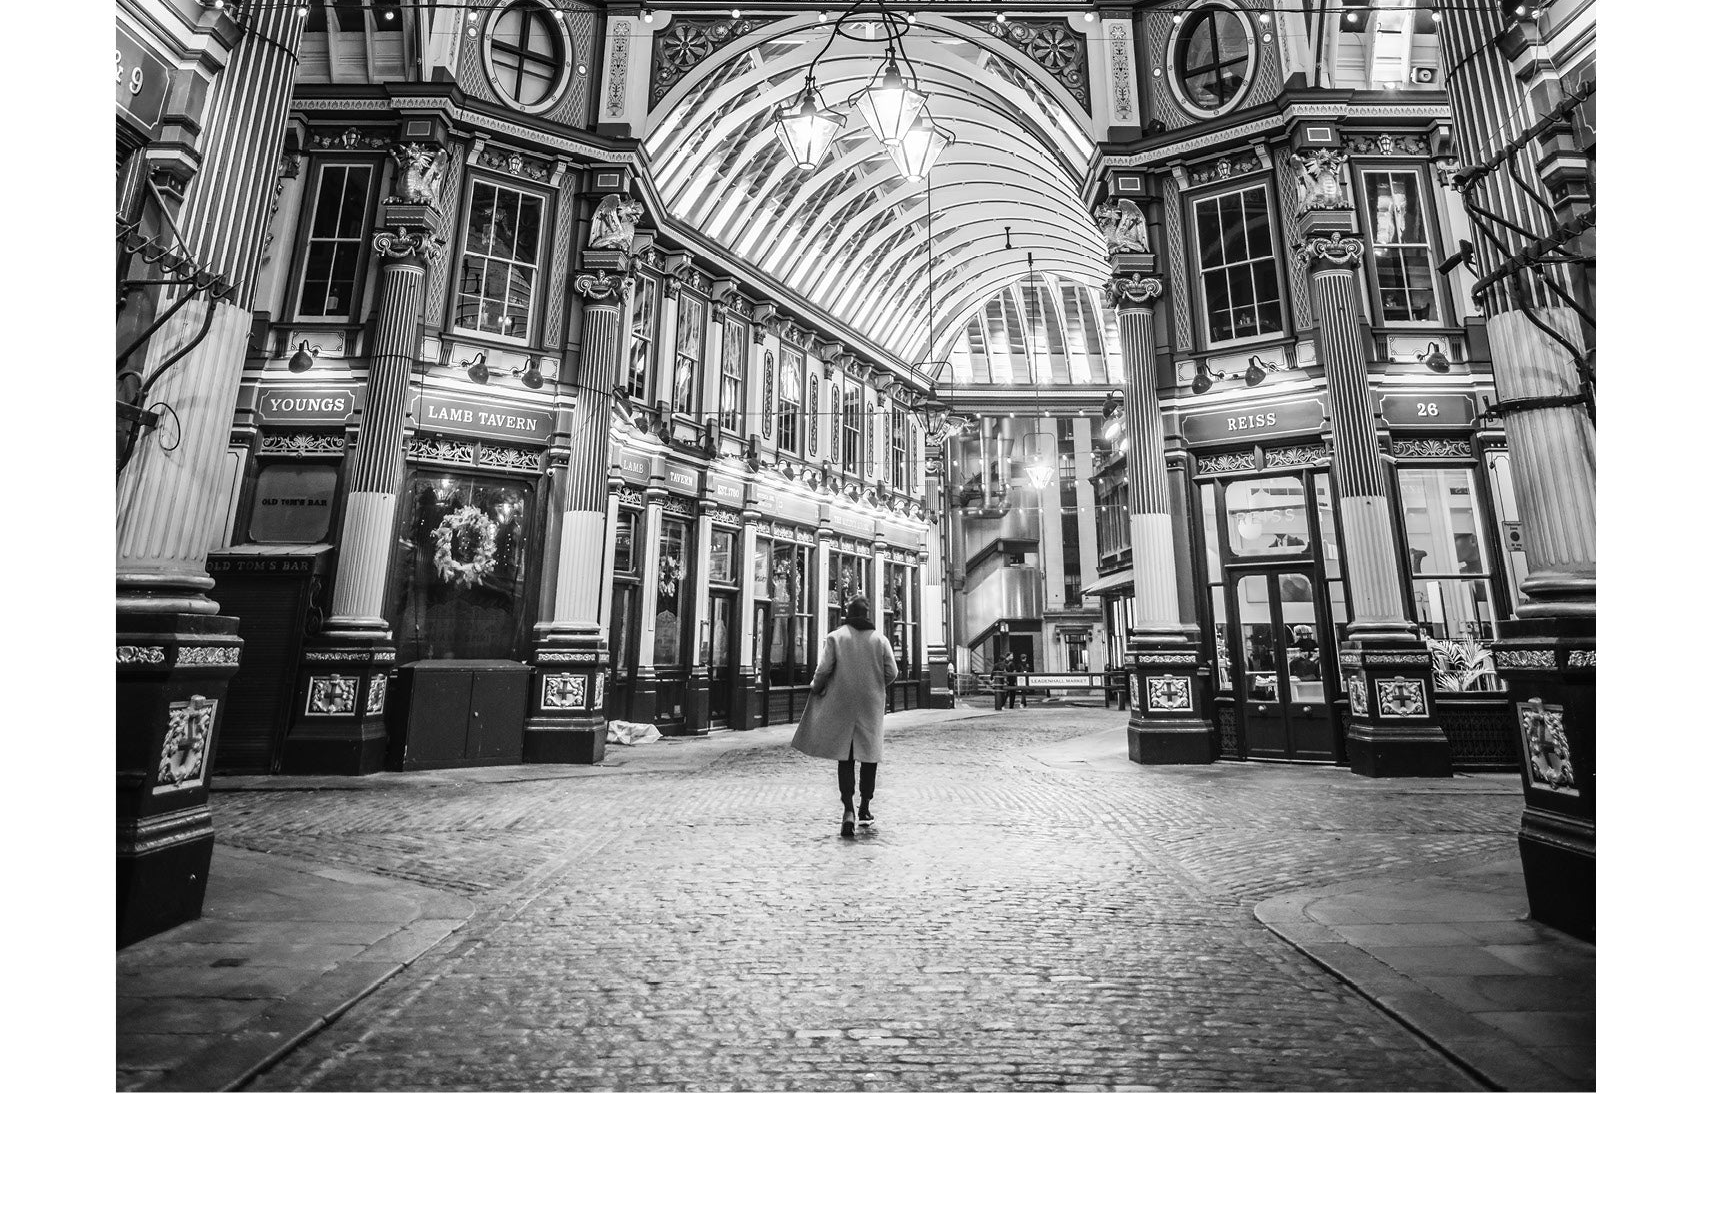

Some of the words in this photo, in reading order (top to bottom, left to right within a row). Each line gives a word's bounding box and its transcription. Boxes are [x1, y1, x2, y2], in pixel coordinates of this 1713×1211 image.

[129, 66, 144, 96] 9
[270, 398, 345, 412] YOUNGS
[1416, 403, 1439, 416] 26
[428, 405, 474, 423] LAMB
[478, 412, 538, 431] TAVERN
[1227, 412, 1277, 431] REISS
[623, 459, 644, 474] LAMB
[670, 471, 694, 487] TAVERN
[261, 498, 278, 506] OLD
[307, 498, 328, 507] BAR
[206, 561, 231, 571] OLD
[282, 561, 309, 571] BAR
